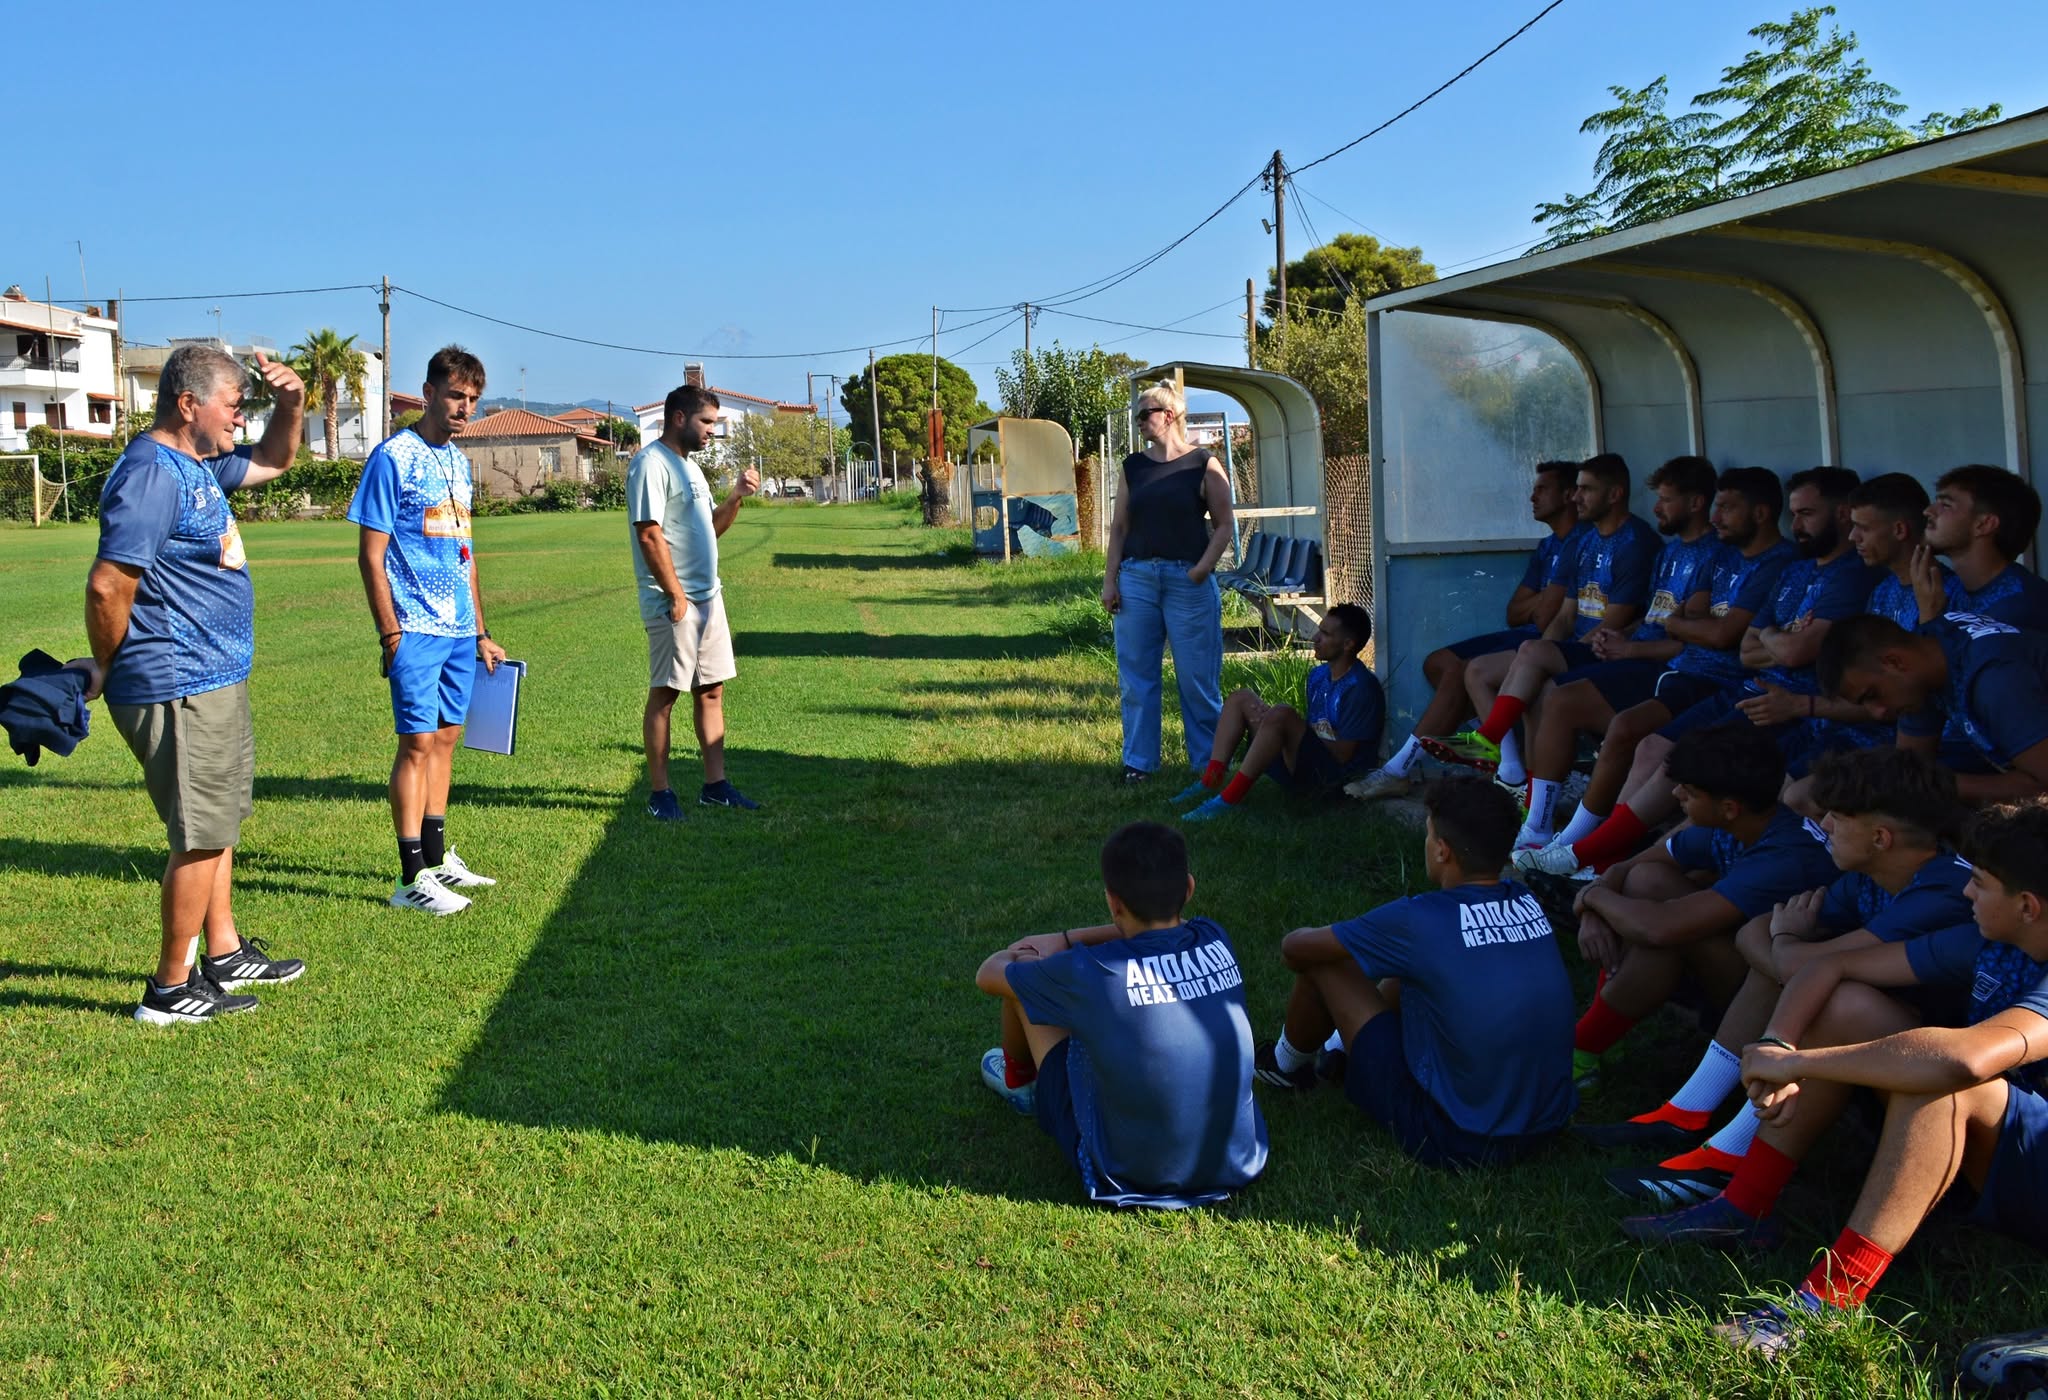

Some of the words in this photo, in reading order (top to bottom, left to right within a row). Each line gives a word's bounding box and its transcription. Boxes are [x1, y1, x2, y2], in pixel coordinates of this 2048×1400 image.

[1459, 893, 1545, 931] ΑΠΟΛΛΩΝ
[1461, 926, 1506, 948] ΝΕΑΣ
[1126, 940, 1237, 988] ΑΠΟΛΛΩΝ
[1126, 984, 1178, 1007] ΝΕΑΣ
